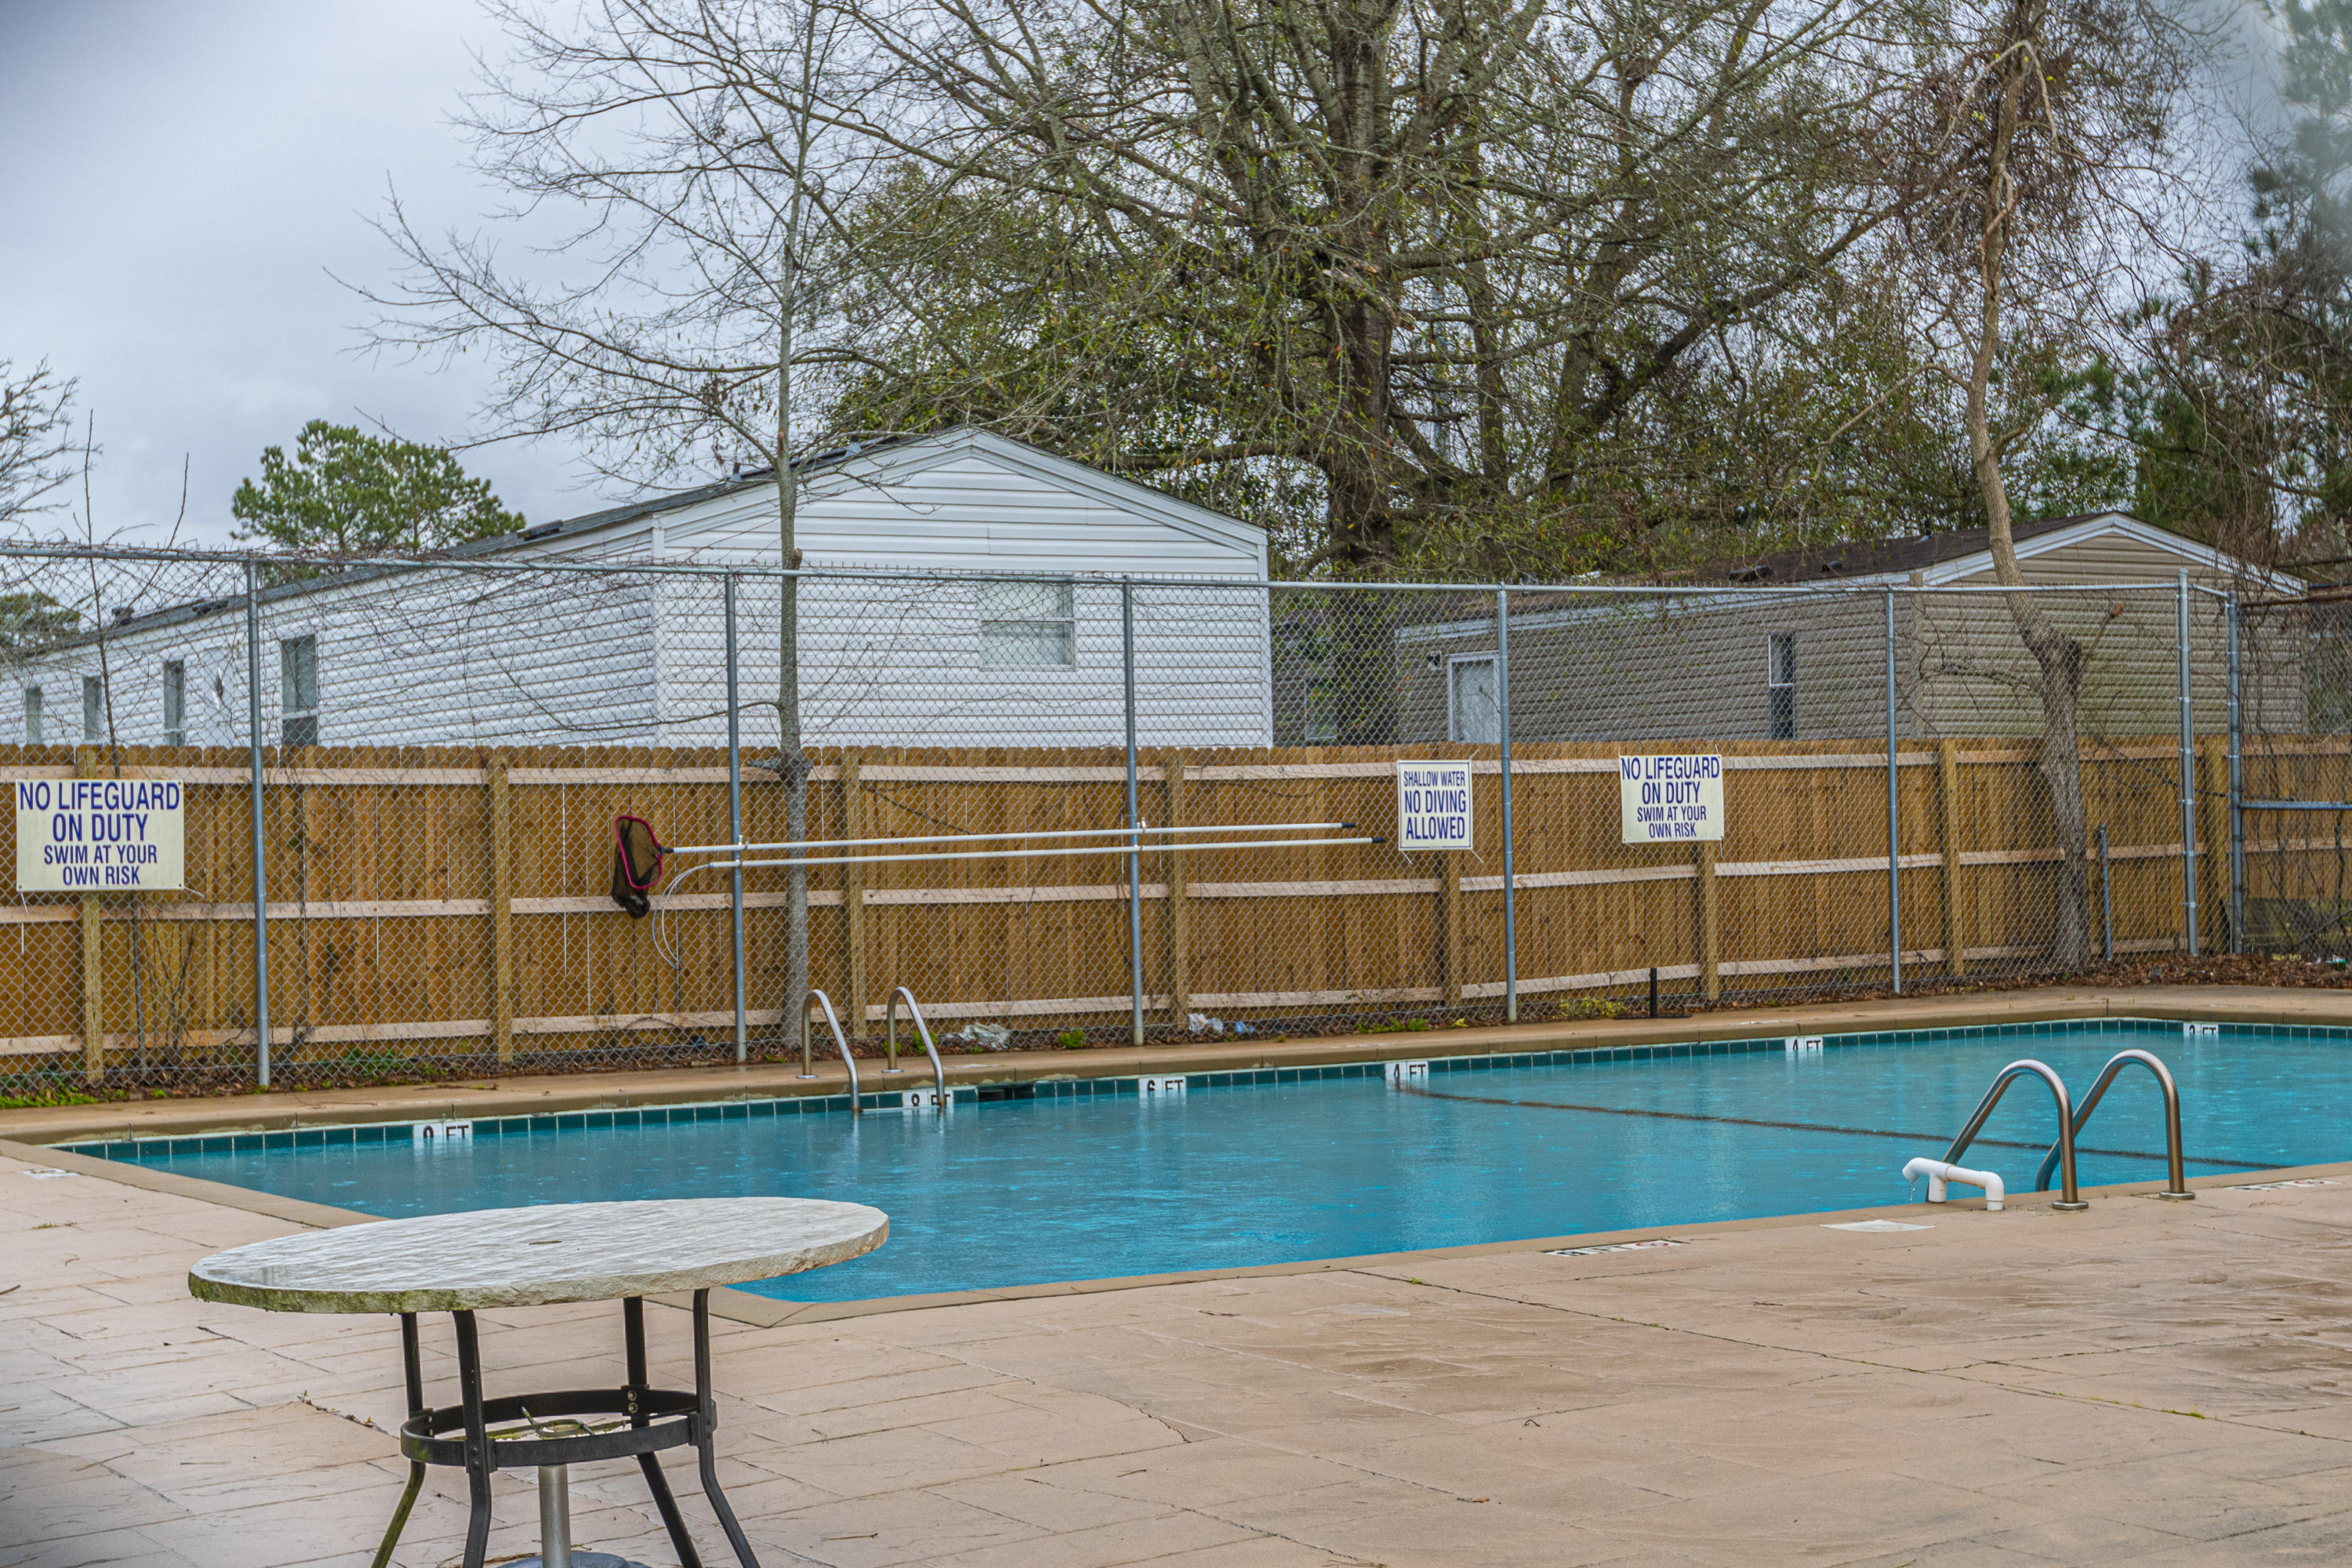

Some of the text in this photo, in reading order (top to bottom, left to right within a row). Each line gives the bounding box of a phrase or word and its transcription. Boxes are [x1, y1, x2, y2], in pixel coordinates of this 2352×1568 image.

[1621, 757, 1720, 780] NO LIFEGUARD
[1403, 771, 1465, 787] SHALLOW WATER
[20, 781, 180, 811] NO LIFEGUARD
[1404, 789, 1466, 814] NO DIVING
[1642, 781, 1700, 804] ON DUTY
[1637, 805, 1707, 822] SWIM AT YOUR
[53, 813, 148, 842] ON DUTY
[1406, 816, 1465, 840] ALLOWED
[1649, 822, 1697, 838] OWN RISK
[44, 844, 158, 864] SWIM AT YOUR
[63, 866, 140, 885] OWN RISK
[1409, 1064, 1426, 1075] FT
[1165, 1080, 1184, 1091] FT
